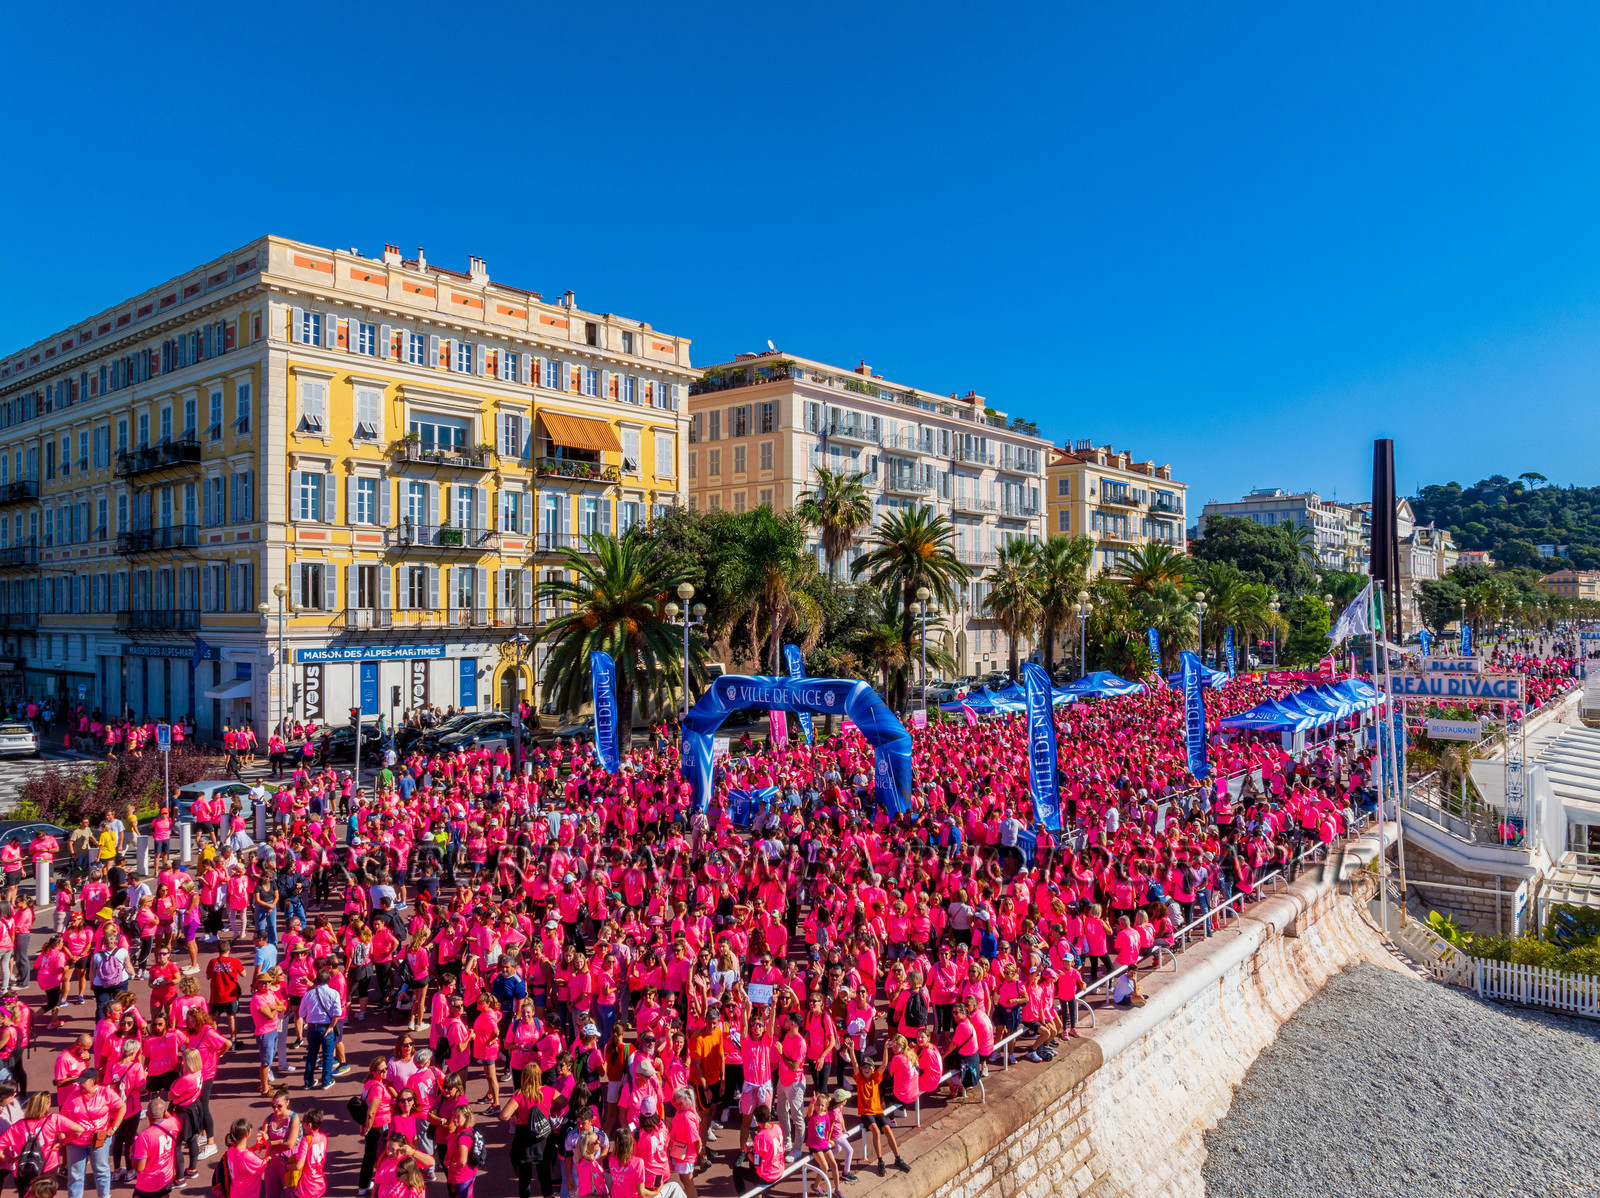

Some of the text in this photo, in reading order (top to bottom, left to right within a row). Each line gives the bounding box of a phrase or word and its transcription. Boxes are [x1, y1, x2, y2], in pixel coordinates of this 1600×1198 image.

[129, 646, 149, 655] MAISON
[150, 648, 160, 656] DES
[304, 648, 440, 660] MAISON DES ALPES-MARITIMES
[1432, 662, 1473, 670] PLAGE
[306, 666, 320, 717] VOUS
[414, 662, 425, 708] VOUS
[1392, 676, 1442, 694] BEAU
[1448, 678, 1518, 698] RIVAGE
[740, 686, 822, 706] VILLE DE NICE
[598, 669, 613, 752] VILLE DE NICE
[1187, 668, 1202, 757] VILLE DE NICE
[1432, 726, 1476, 735] RESTAURANT
[1032, 687, 1052, 800] VILLE DE NICE
[90, 891, 100, 901] N
[418, 1079, 434, 1099] N
[159, 1134, 173, 1154] N
